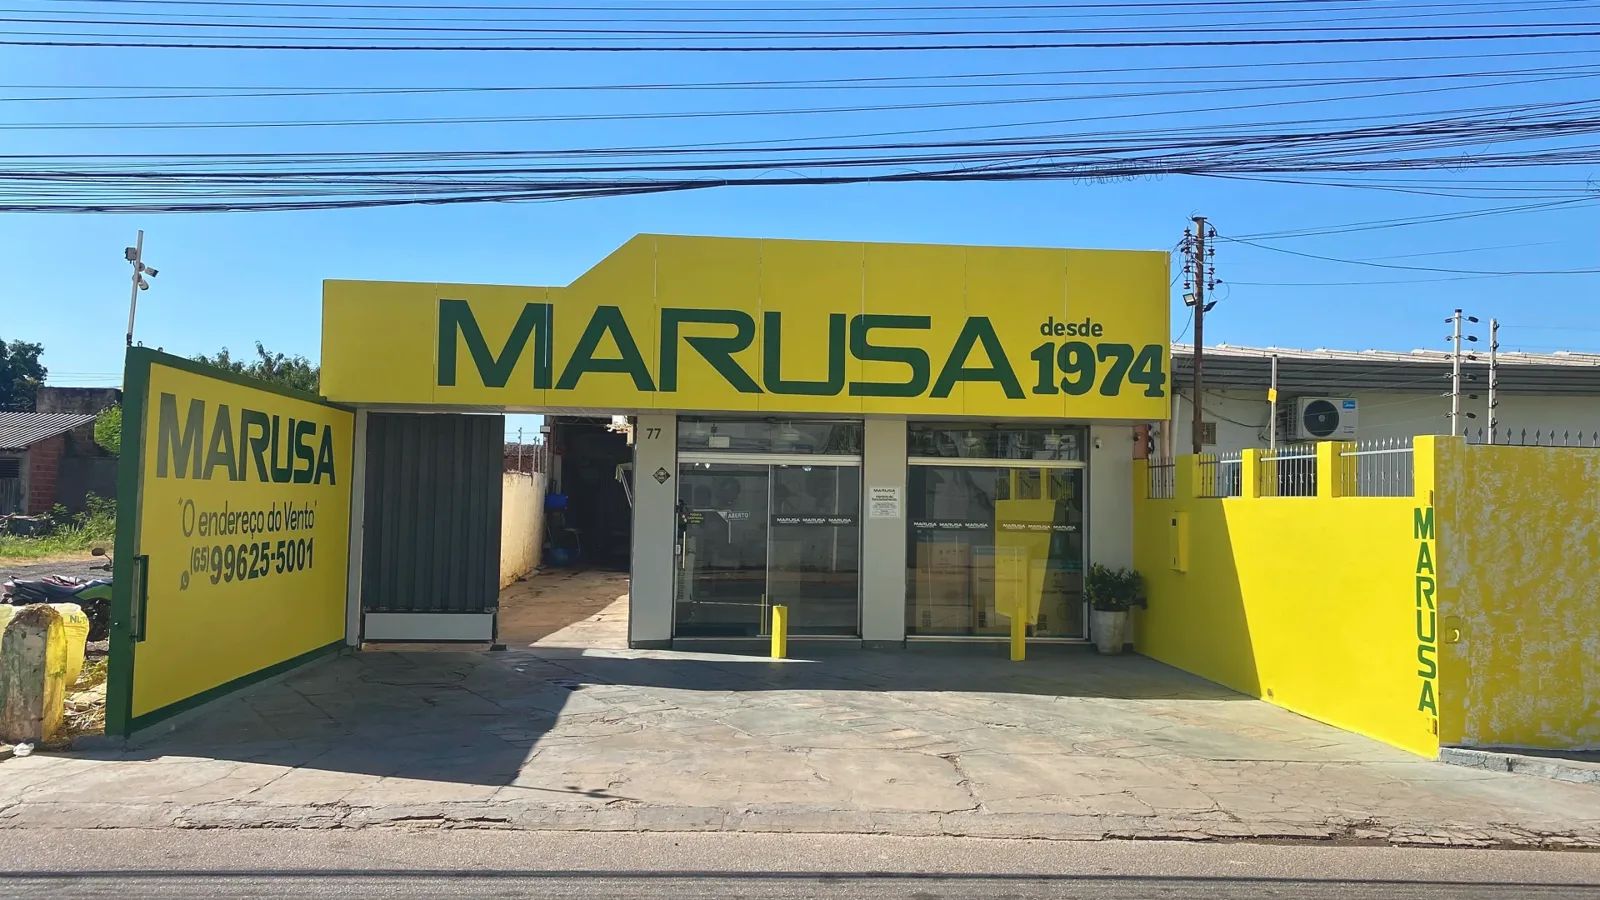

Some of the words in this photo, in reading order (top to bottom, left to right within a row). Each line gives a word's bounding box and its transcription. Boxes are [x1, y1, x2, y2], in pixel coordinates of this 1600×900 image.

[438, 299, 1025, 399] MARUSA
[1041, 316, 1103, 337] desde
[1031, 342, 1166, 397] 1974
[156, 391, 336, 486] MARUSA
[646, 427, 662, 440] 77
[198, 500, 265, 539] endereço
[267, 501, 282, 532] do
[1413, 507, 1438, 717] MARUSA
